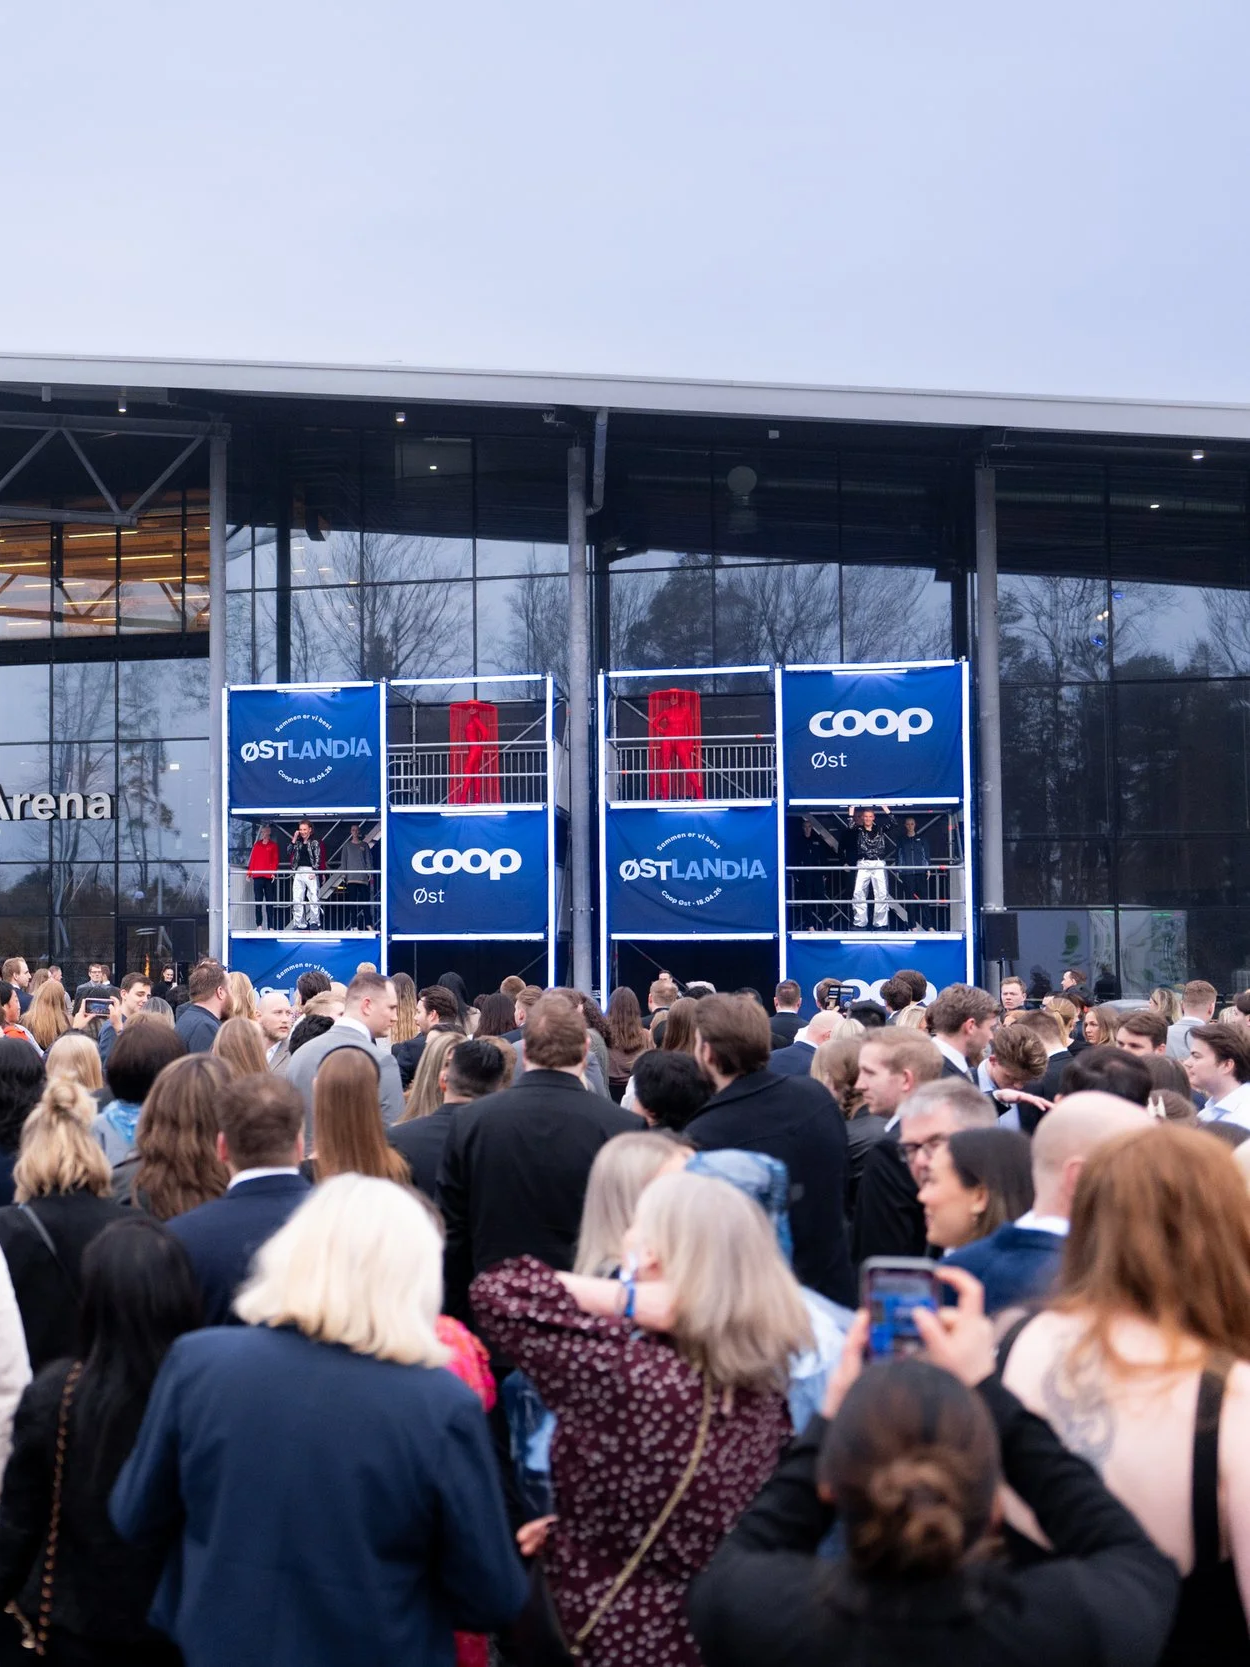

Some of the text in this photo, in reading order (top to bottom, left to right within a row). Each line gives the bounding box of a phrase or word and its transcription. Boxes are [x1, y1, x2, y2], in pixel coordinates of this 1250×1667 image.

[275, 714, 302, 732] Sammen
[318, 717, 332, 730] best
[809, 707, 934, 742] coop
[240, 737, 373, 763] ØSTLANDIA
[811, 751, 848, 769] Øst
[278, 769, 293, 782] Coop
[656, 832, 686, 851] Sammen
[705, 836, 721, 850] best
[411, 848, 523, 881] coop
[619, 857, 768, 882] ØSTLANDIA
[413, 887, 445, 905] Øst
[661, 890, 678, 904] Coop
[276, 962, 304, 979] Sammen
